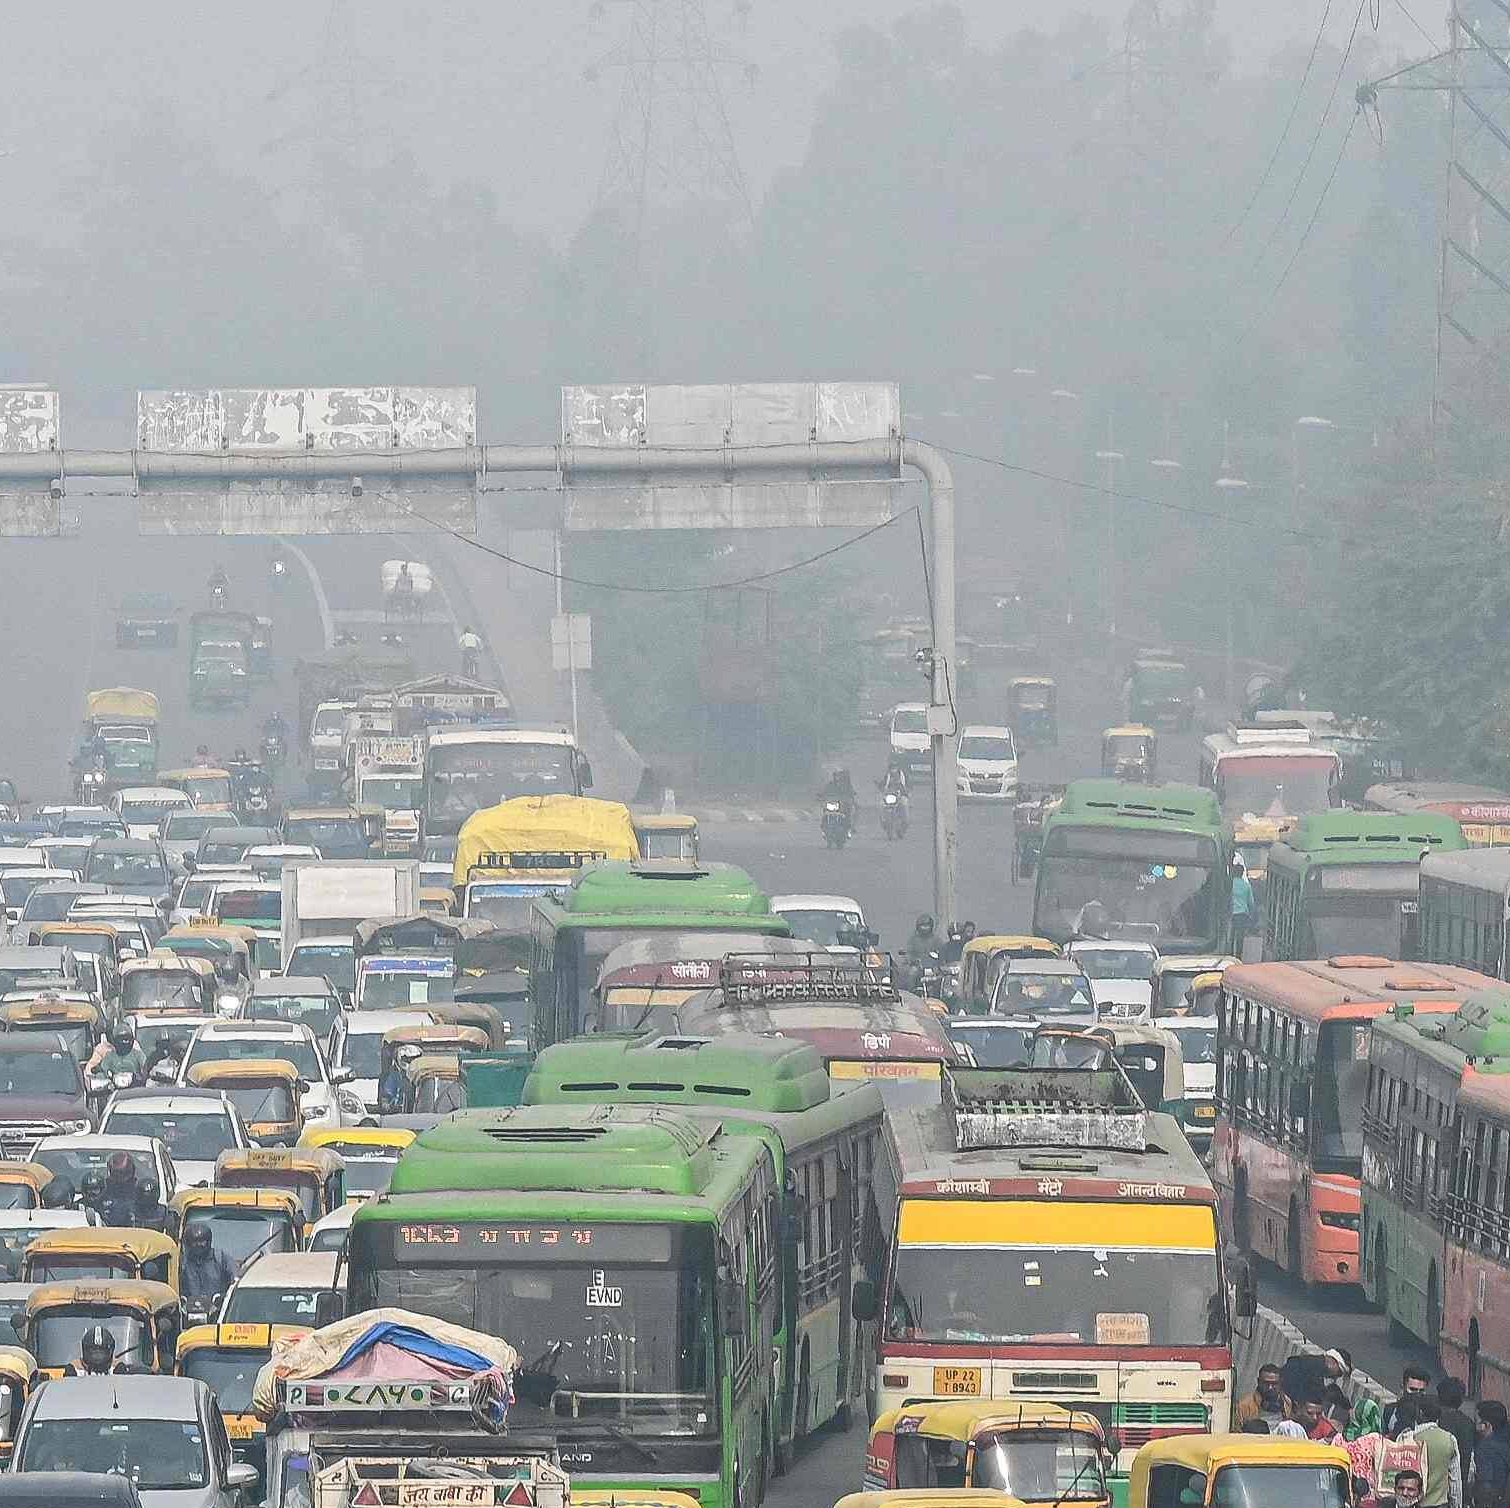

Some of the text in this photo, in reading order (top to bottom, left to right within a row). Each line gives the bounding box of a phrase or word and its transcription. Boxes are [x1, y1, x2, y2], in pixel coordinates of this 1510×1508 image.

[594, 1271, 602, 1287] E
[946, 1370, 975, 1381] UP 22
[952, 1383, 977, 1393] 8943
